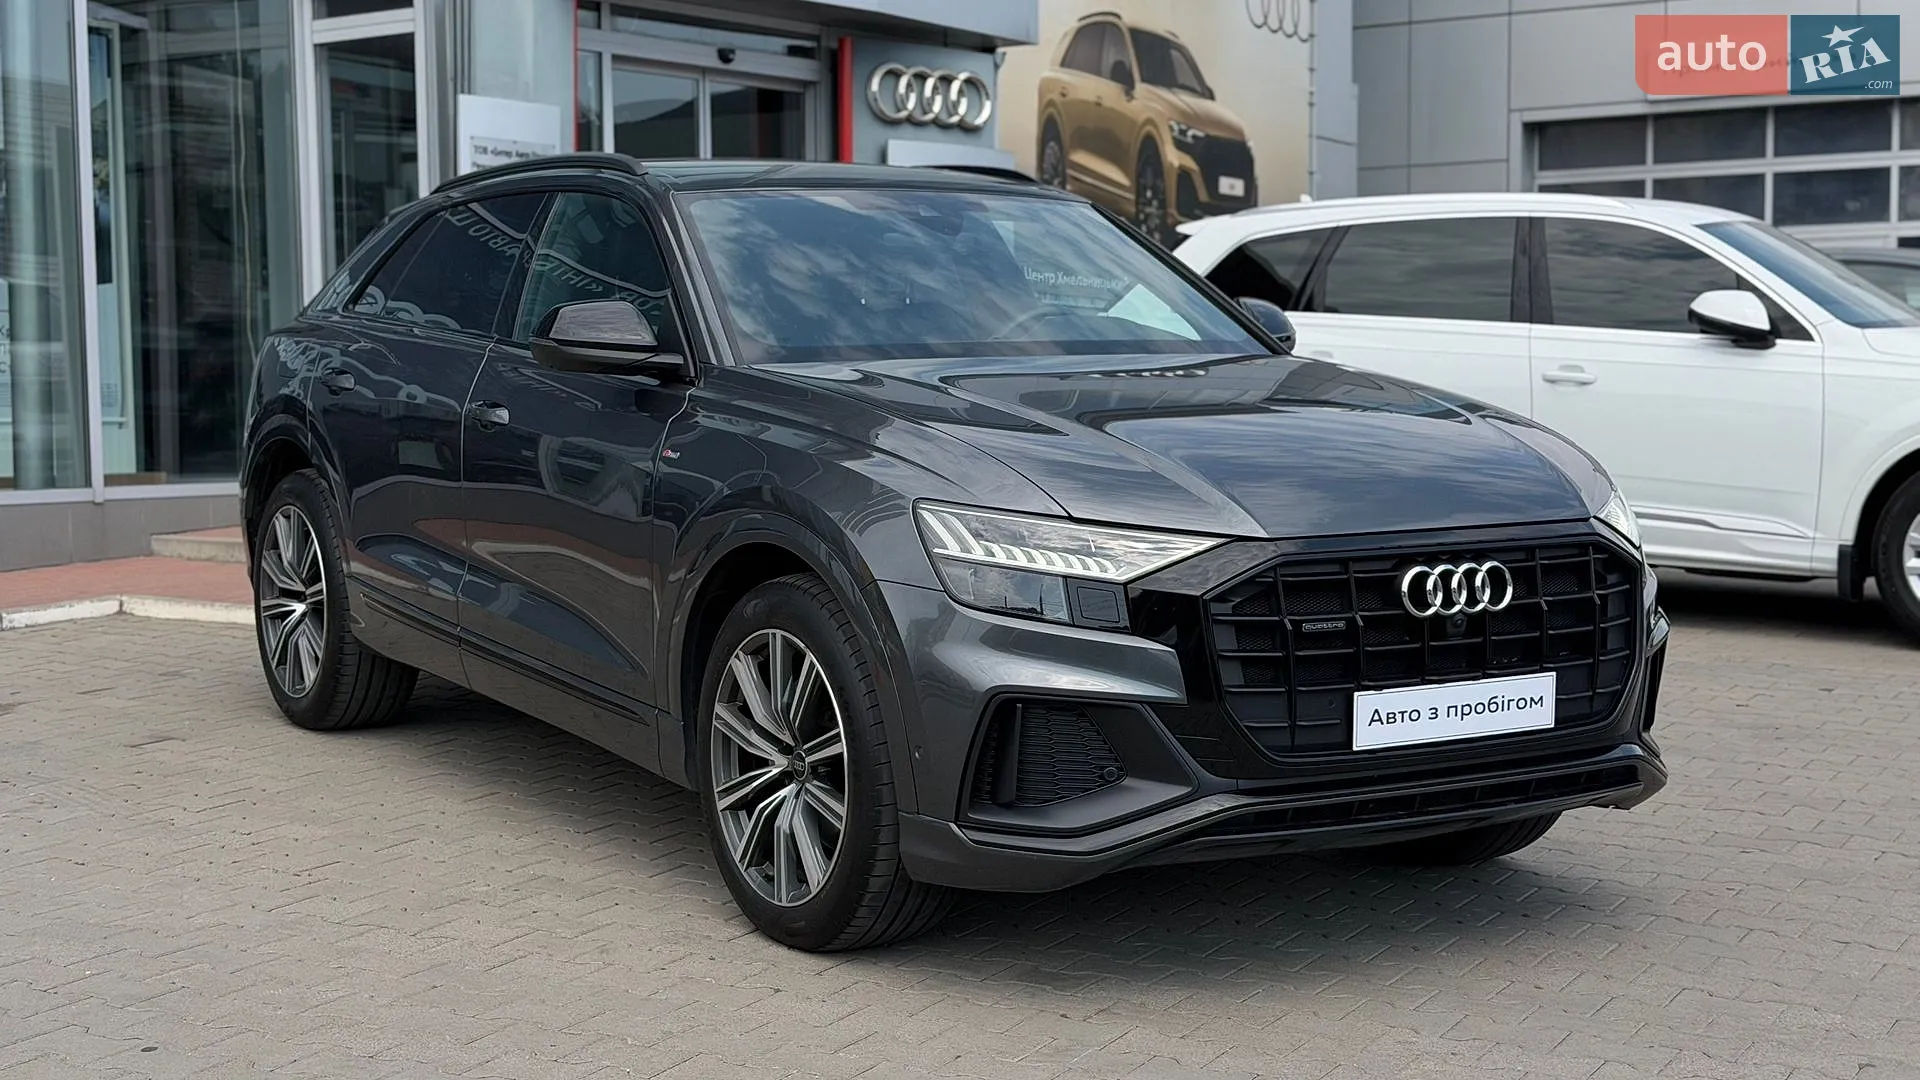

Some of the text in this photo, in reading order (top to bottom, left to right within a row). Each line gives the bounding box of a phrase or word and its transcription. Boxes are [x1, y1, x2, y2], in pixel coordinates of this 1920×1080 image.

[1022, 266, 1056, 285] Центр
[1304, 622, 1345, 632] quattro
[1367, 694, 1544, 727] Авто з пробігом
